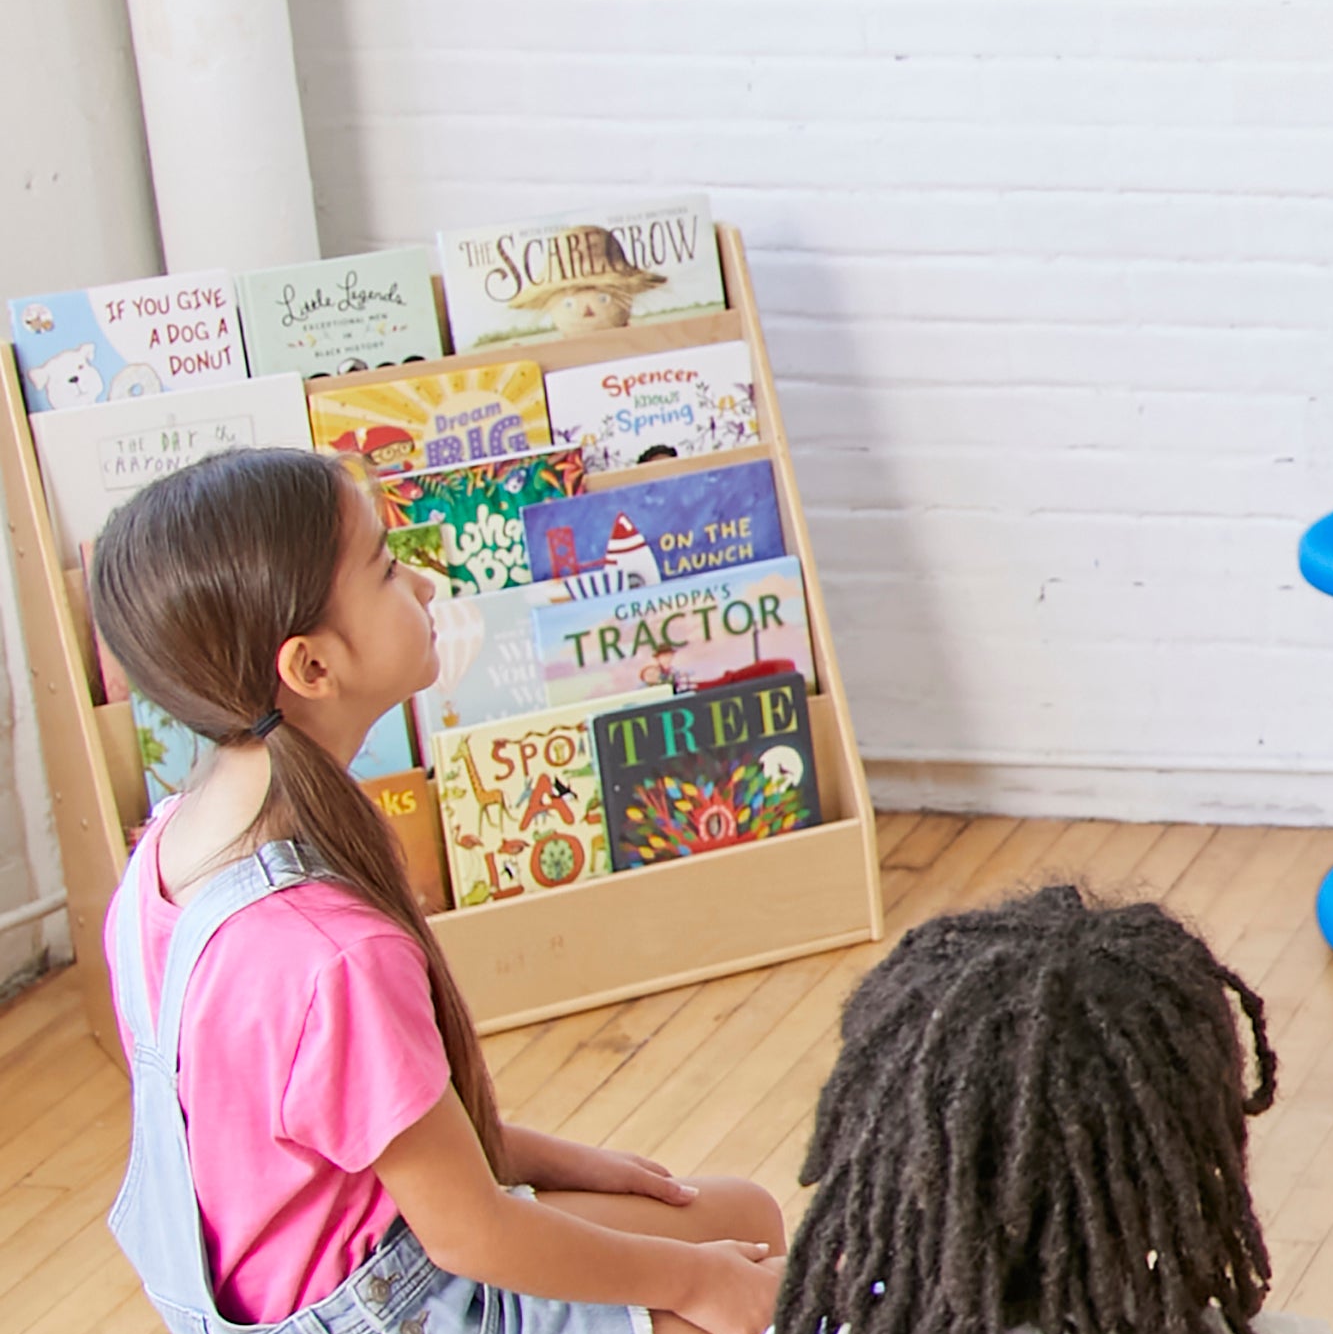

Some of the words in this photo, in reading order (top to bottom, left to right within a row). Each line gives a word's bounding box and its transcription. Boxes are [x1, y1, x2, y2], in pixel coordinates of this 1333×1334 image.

[484, 213, 699, 304] SCARECROW
[105, 299, 126, 324] IF
[132, 294, 170, 318] YOU
[177, 287, 227, 310] GIVE
[275, 282, 337, 328] Little
[335, 269, 408, 312] Legends
[149, 327, 161, 350] A
[166, 321, 210, 345] DOG
[217, 317, 229, 339] A
[168, 345, 233, 377] DONUT
[601, 368, 699, 397] Spencer
[434, 401, 503, 435] Dream
[615, 403, 695, 436] Spring
[424, 413, 531, 468] BIG
[659, 529, 694, 552] ON
[704, 517, 752, 544] THE
[663, 543, 754, 577] LAUNCH
[614, 582, 732, 621] GRANDPA'S
[564, 593, 784, 668] TRACTOR
[609, 685, 799, 768] TREE
[518, 772, 576, 832] A
